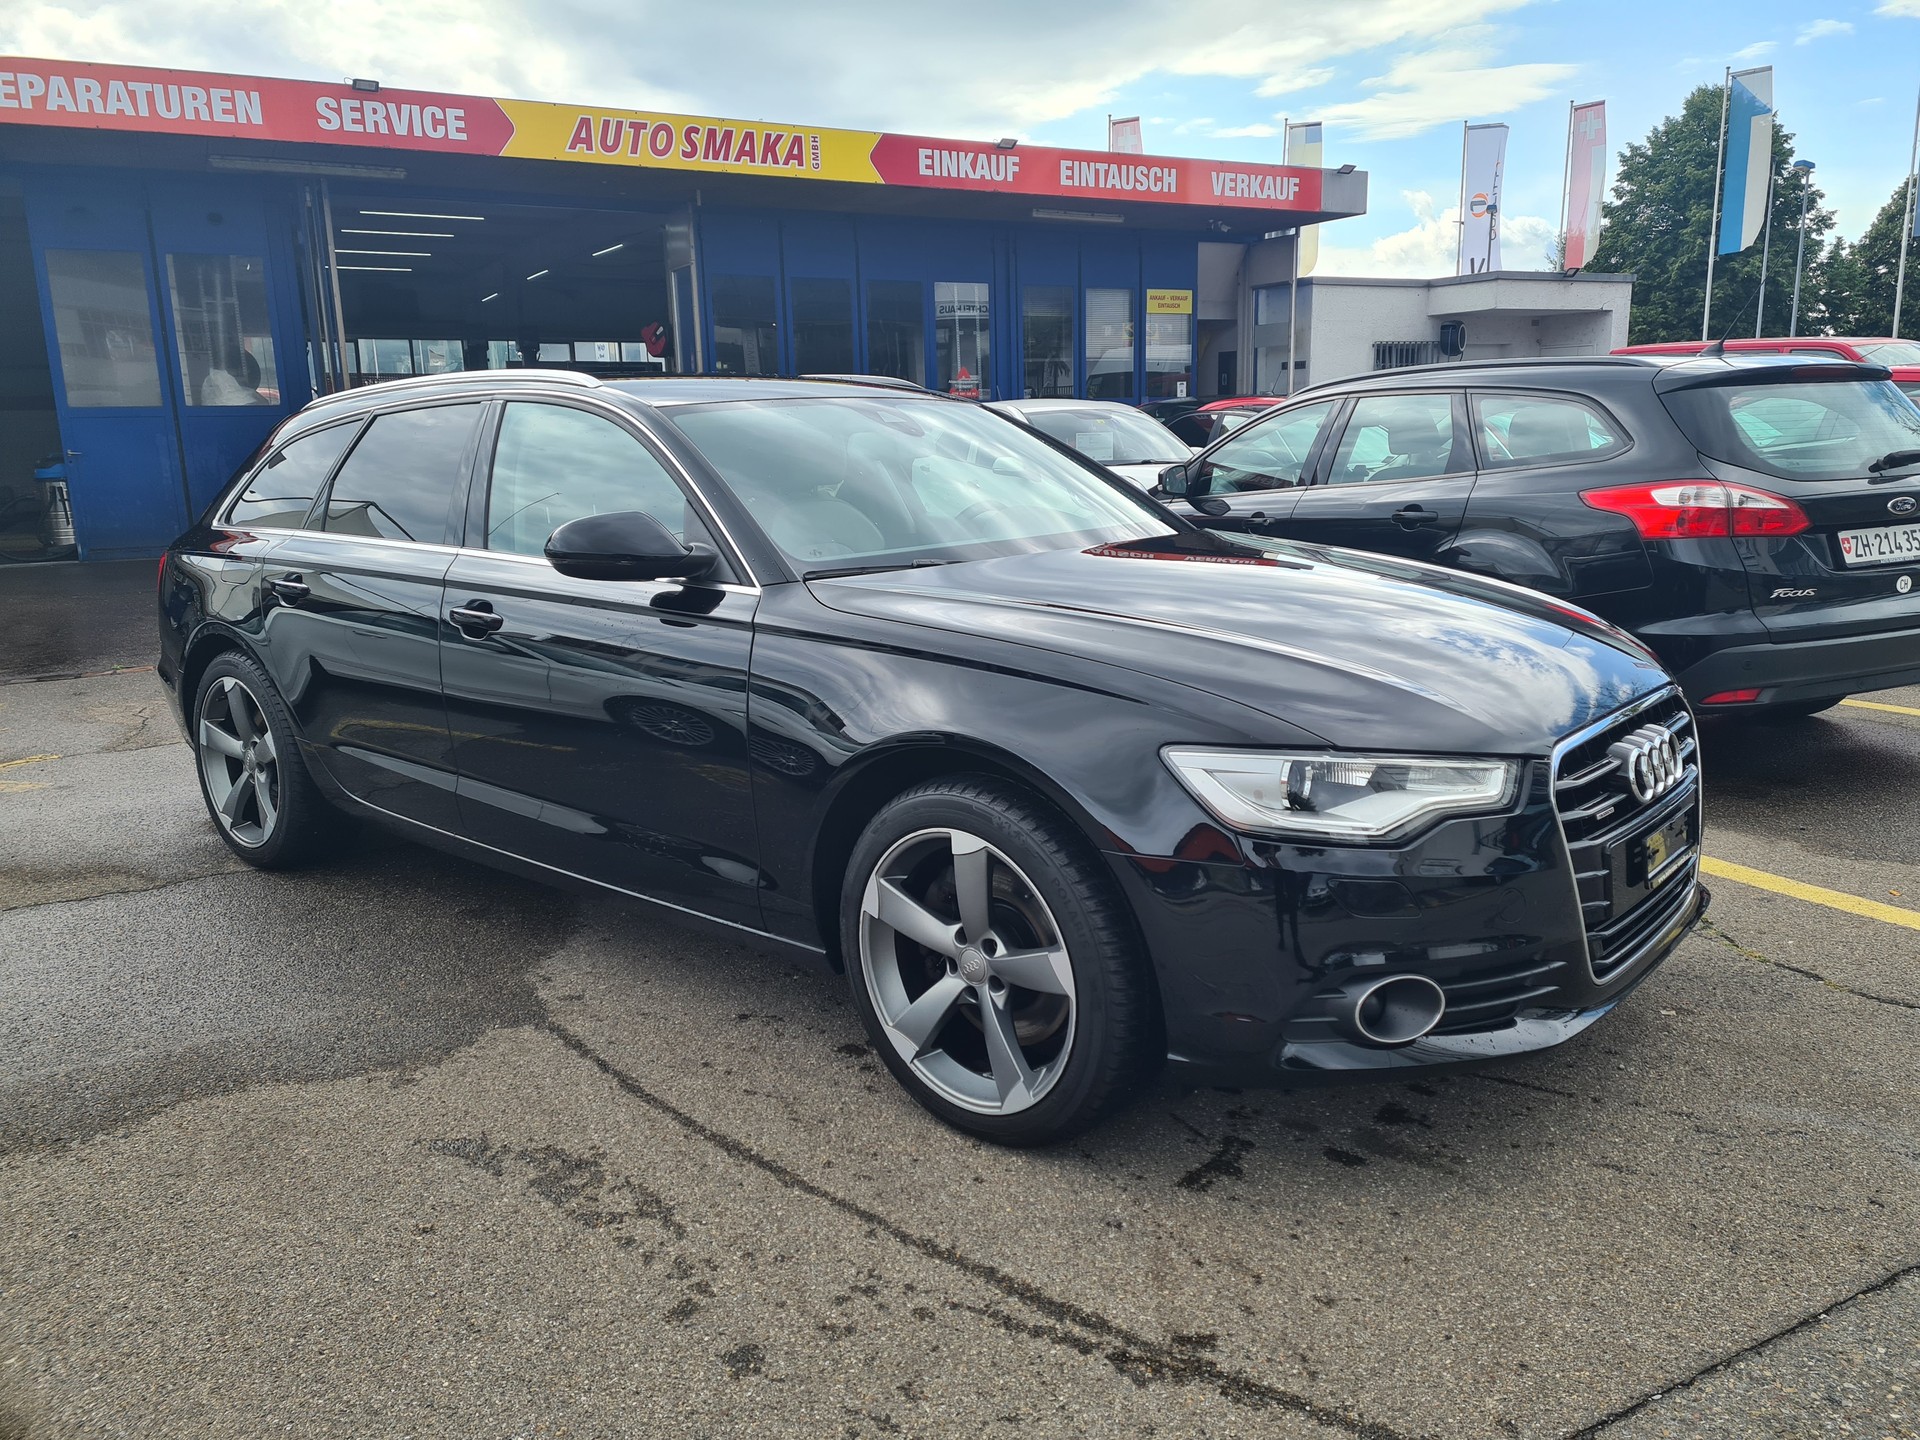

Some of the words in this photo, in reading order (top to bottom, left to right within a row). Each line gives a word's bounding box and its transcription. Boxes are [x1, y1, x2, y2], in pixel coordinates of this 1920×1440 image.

[0, 71, 264, 126] EPARATUREN
[315, 96, 468, 141] SERVICE
[567, 116, 675, 159] AUTO
[681, 125, 806, 168] SMAKA
[810, 134, 820, 171] GMBH
[917, 148, 1020, 182] EINKAUF
[1059, 159, 1178, 193] EINTAUSCH
[1210, 171, 1300, 202] VERKAUF
[1899, 578, 1909, 590] CH
